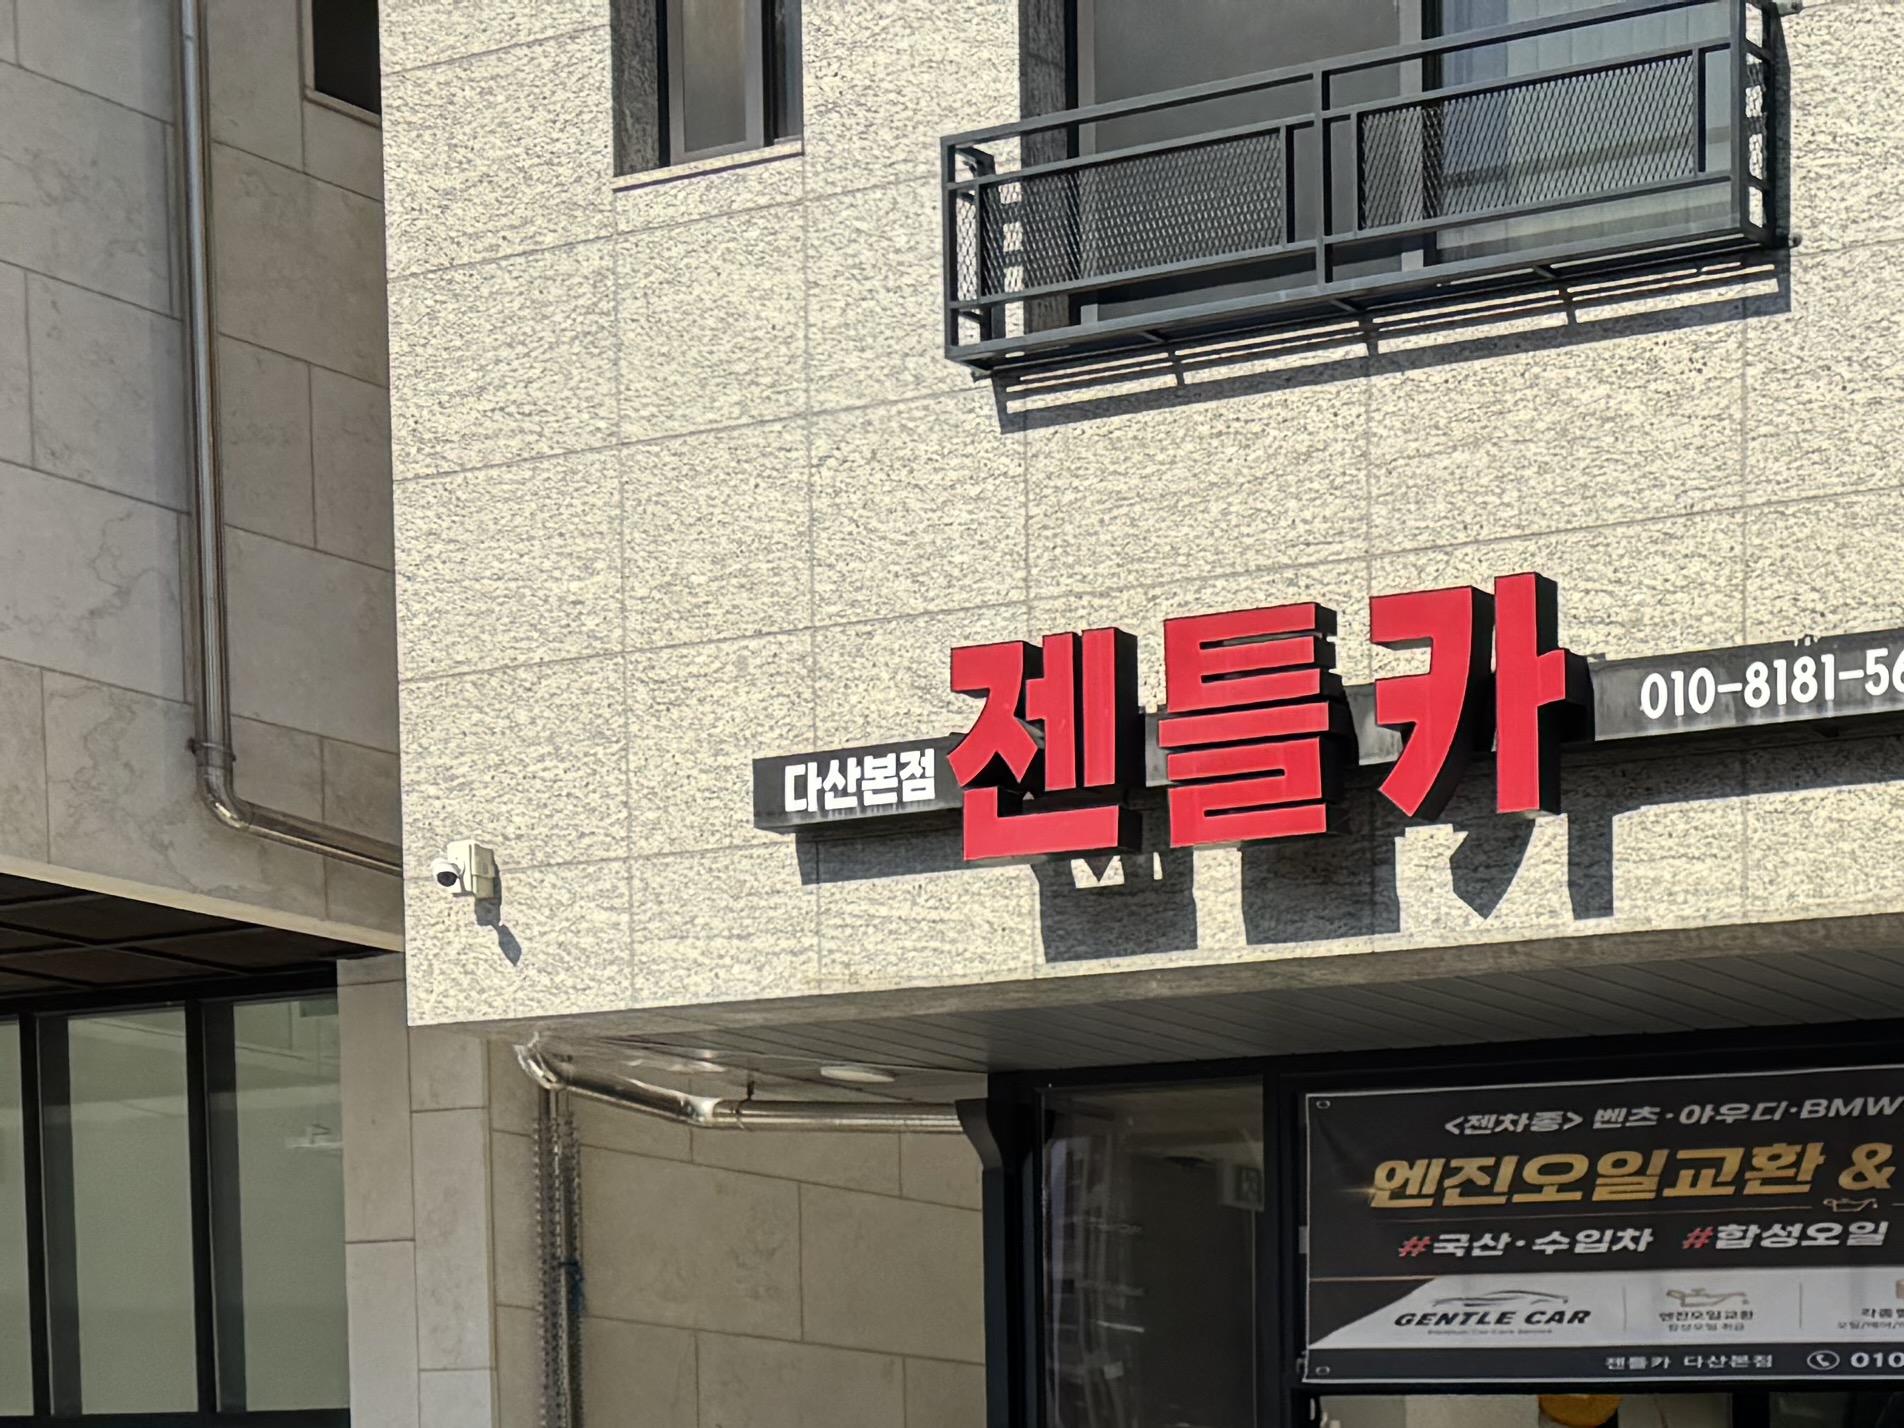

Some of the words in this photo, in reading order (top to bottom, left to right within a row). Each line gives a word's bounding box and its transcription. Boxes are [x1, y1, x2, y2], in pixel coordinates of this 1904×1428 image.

[948, 572, 1565, 860] 젠틀카
[782, 747, 938, 812] 다산본점
[1370, 1141, 1826, 1209] 엔진오일교환
[1838, 1142, 1897, 1192] &
[1683, 1220, 1889, 1250] #합성오일
[1394, 1310, 1518, 1328] GENTLE
[1524, 1309, 1592, 1326] CAR
[1605, 1355, 1672, 1371] 젠틀카
[1683, 1354, 1774, 1370] 다산본점
